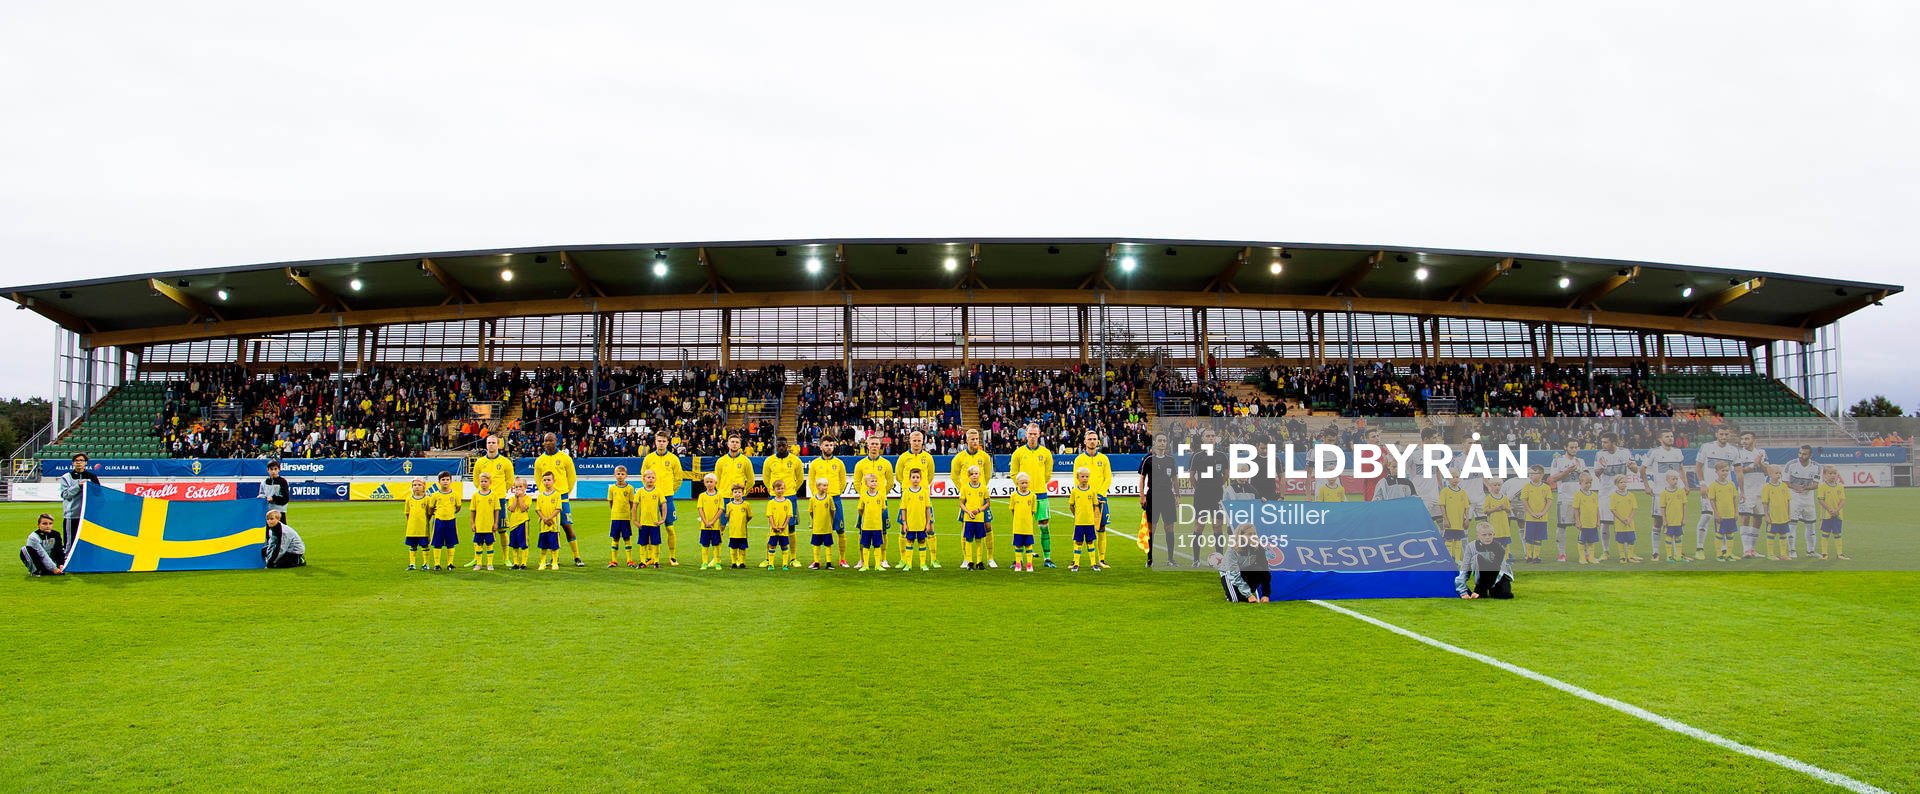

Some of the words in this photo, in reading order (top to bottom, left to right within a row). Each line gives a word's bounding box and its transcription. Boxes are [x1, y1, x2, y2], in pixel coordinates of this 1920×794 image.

[1852, 472, 1876, 484] ICA
[133, 484, 178, 498] Estrella
[185, 484, 230, 499] Estrella
[292, 486, 320, 496] SWEDEN
[1115, 486, 1140, 494] SPEL
[1296, 537, 1440, 566] RESPECT
